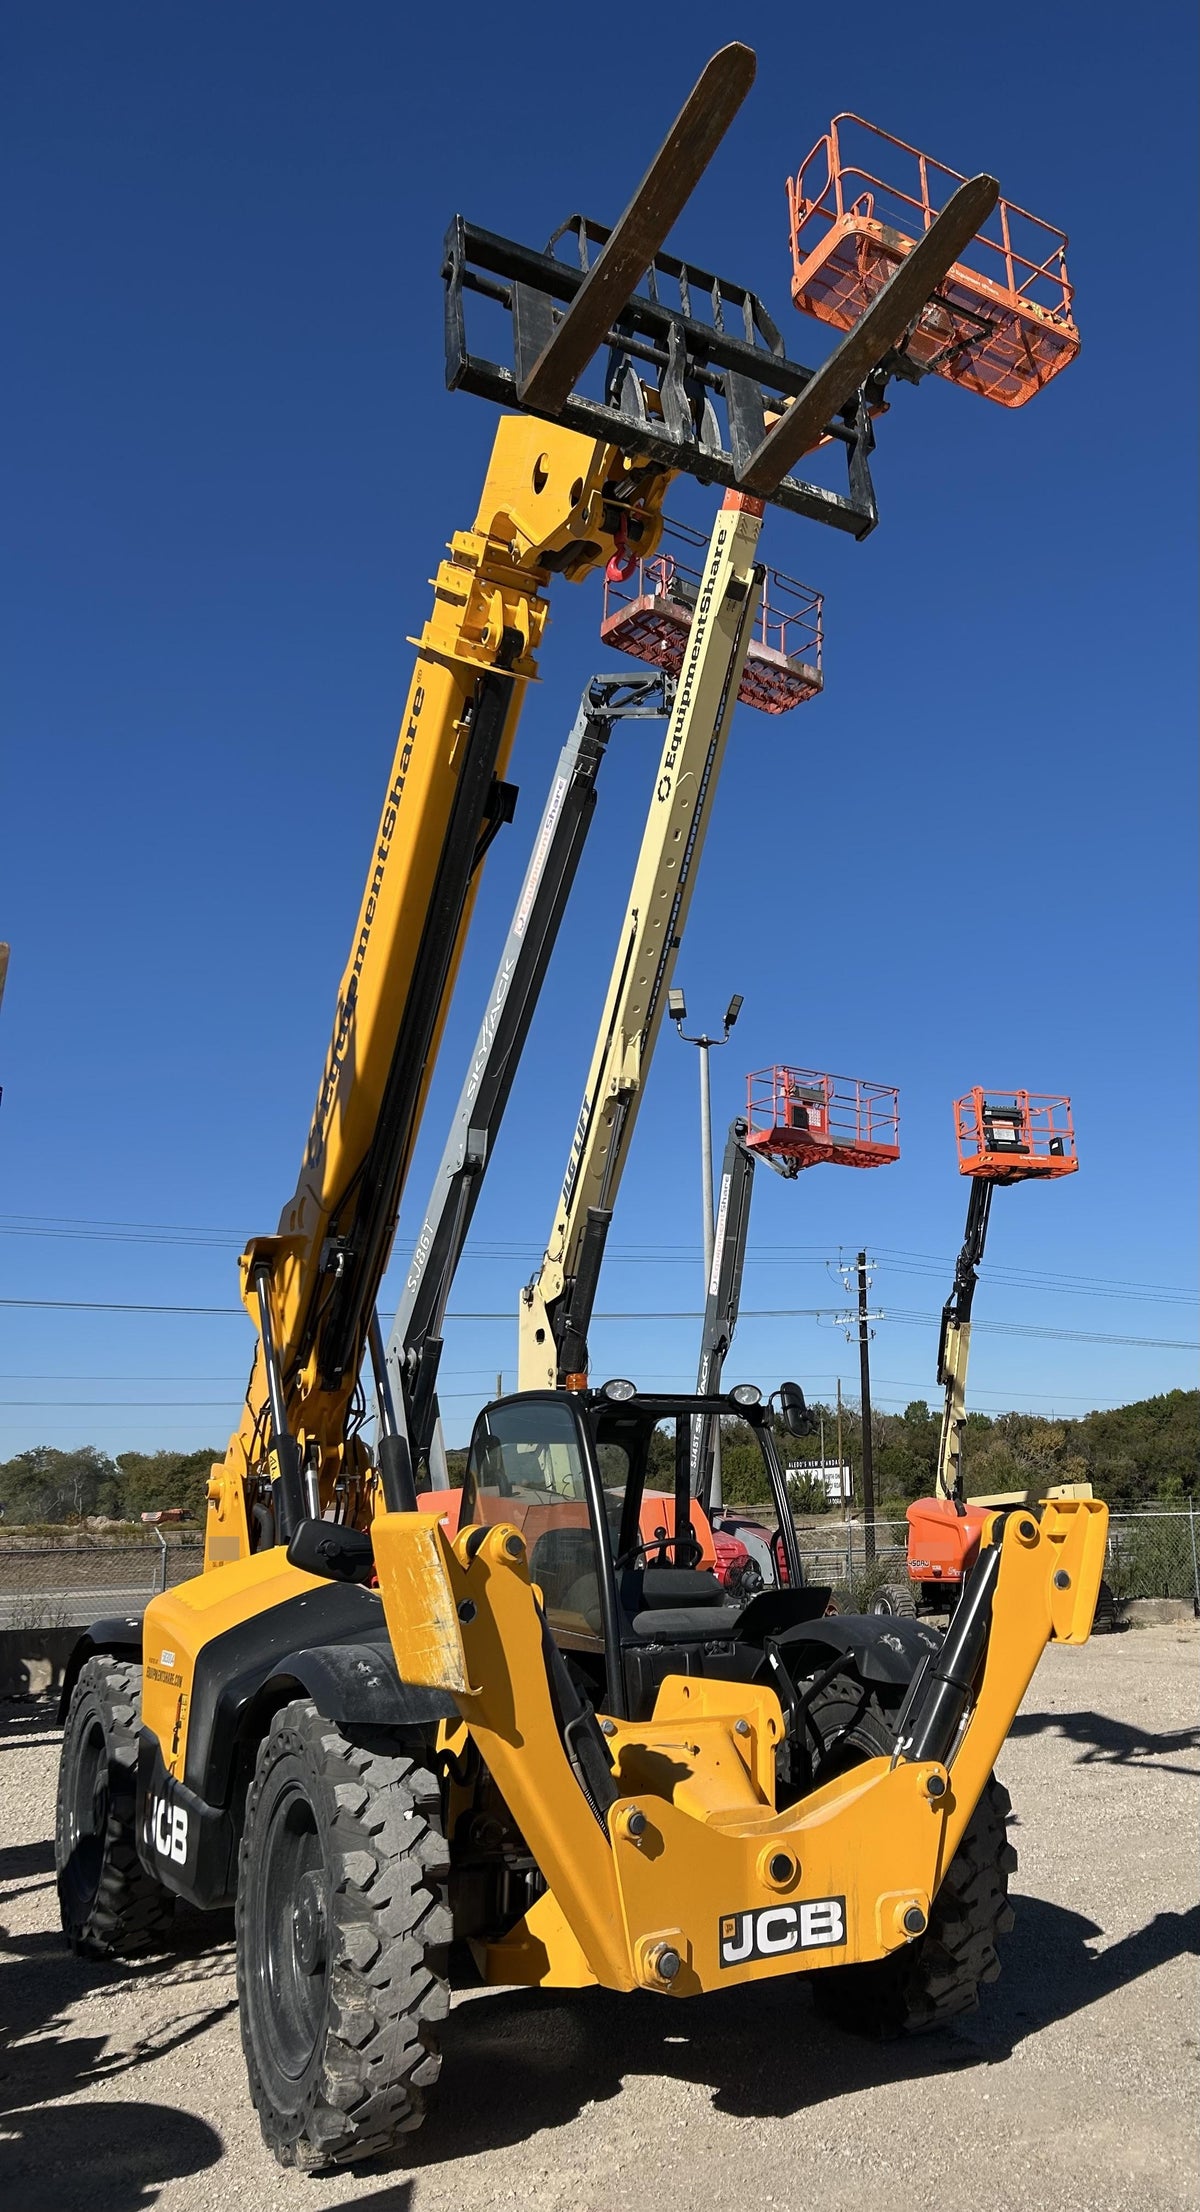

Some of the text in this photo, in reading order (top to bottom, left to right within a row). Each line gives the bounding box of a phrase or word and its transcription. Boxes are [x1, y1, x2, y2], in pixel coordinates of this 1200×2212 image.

[664, 529, 727, 771] EquipmentShare
[320, 684, 425, 1119] EquipmentShare
[522, 780, 565, 915] EquipmentShare
[467, 959, 515, 1100] SKYJACK
[562, 1094, 591, 1209] JLG LIFT
[407, 1217, 434, 1293] SJ86T
[690, 1436, 701, 1469] SJ45T
[723, 1901, 843, 1962] JCB
